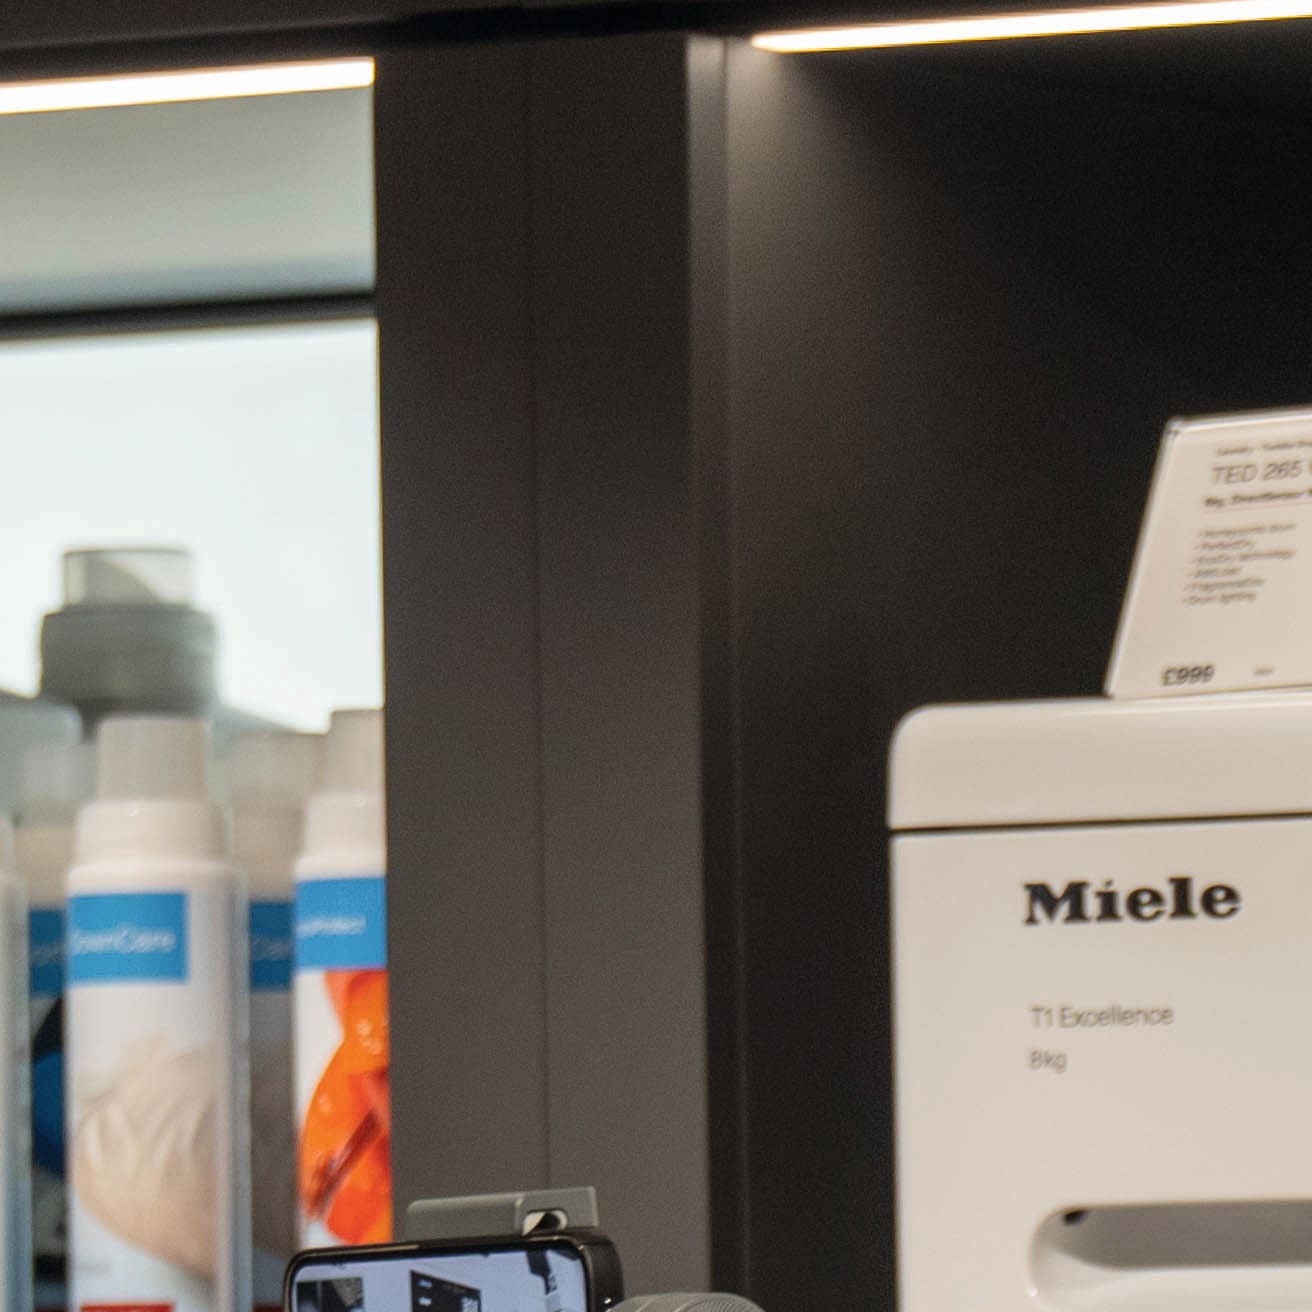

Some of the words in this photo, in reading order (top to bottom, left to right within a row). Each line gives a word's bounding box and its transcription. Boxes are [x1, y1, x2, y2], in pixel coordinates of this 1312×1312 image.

[1212, 463, 1257, 484] TED
[1023, 877, 1241, 926] Miele
[1060, 1004, 1174, 1029] Excellence
[1030, 1049, 1067, 1073] 8kg
